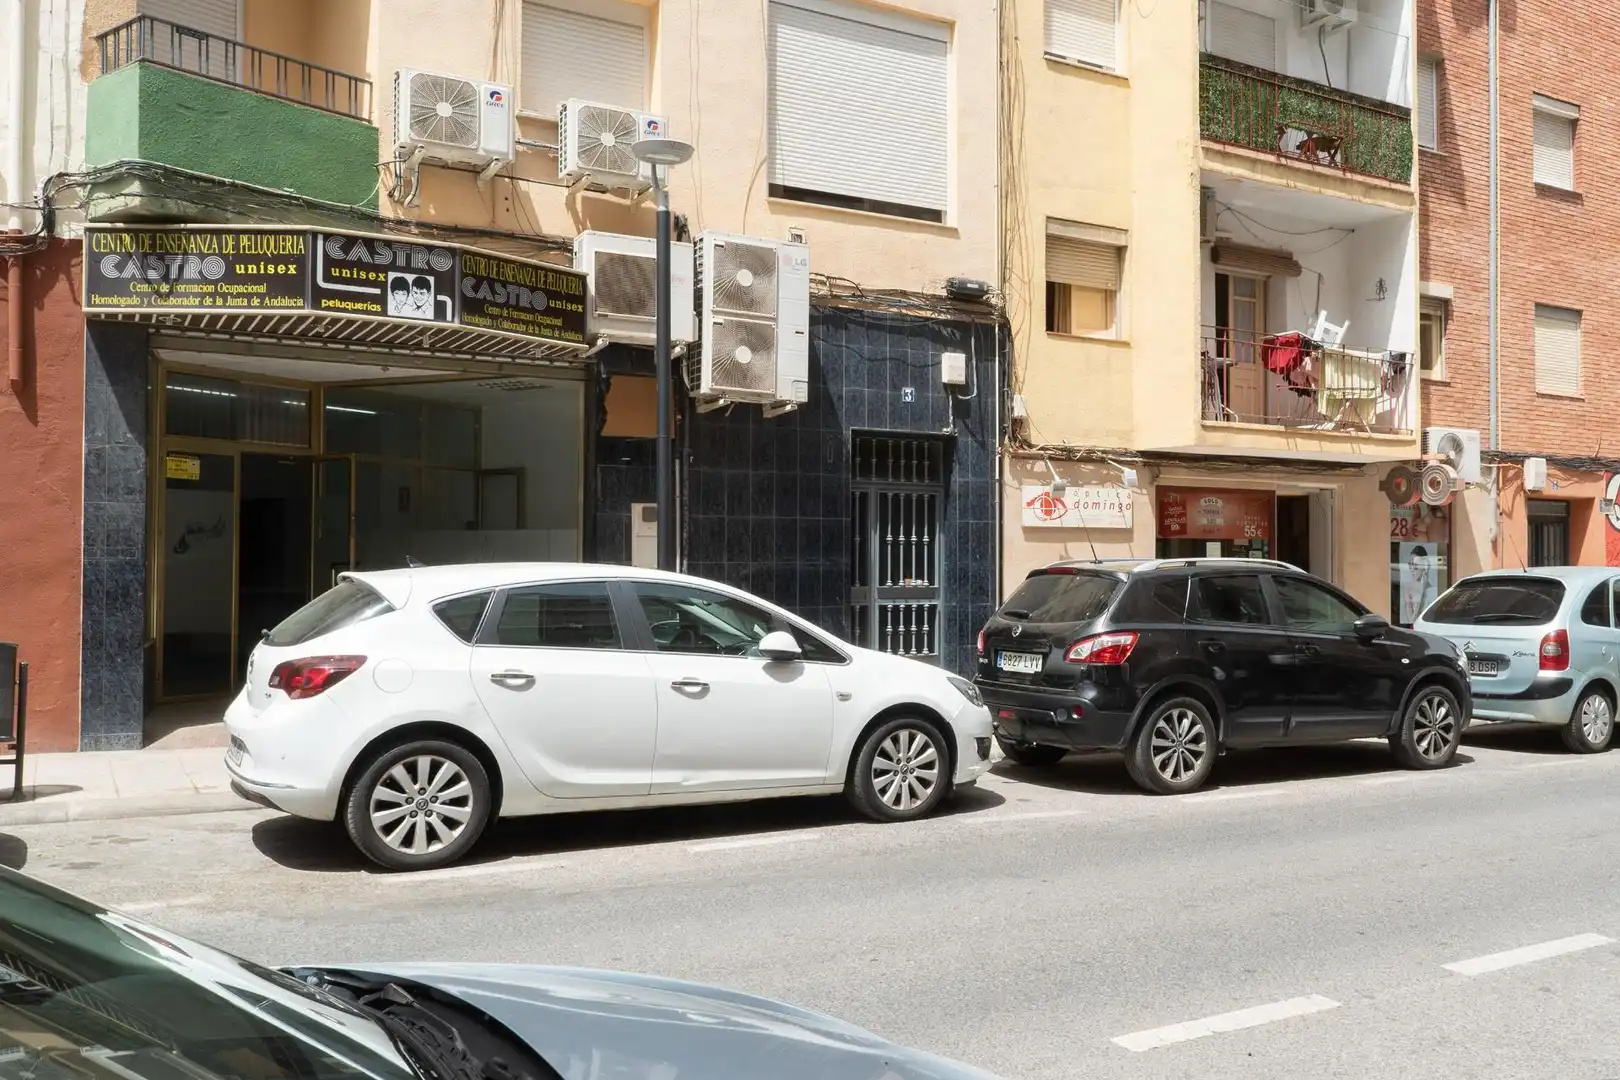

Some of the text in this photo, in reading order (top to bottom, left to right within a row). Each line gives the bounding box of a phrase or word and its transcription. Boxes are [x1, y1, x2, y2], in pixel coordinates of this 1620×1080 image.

[92, 233, 136, 252] CENTRO
[140, 233, 152, 252] DE
[156, 232, 218, 253] ENSEÑANZA
[222, 234, 236, 254] DE
[325, 236, 452, 272] CASTRO
[100, 254, 296, 280] CASTRO unisex
[795, 258, 806, 266] LG
[331, 267, 387, 282] unisex
[462, 254, 488, 276] CENTRO
[490, 260, 498, 279] DE
[538, 270, 546, 288] DE
[130, 281, 157, 292] Centro
[160, 282, 170, 292] de
[218, 282, 266, 294] Ocupacional
[462, 276, 584, 312] CASTRO unisex
[92, 294, 140, 306] Homologado
[143, 298, 149, 306] y
[152, 295, 200, 306] Colaborador
[203, 296, 212, 306] de
[216, 296, 222, 306] la
[226, 296, 248, 306] Junta
[250, 296, 260, 306] de
[904, 390, 912, 402] 3
[1074, 500, 1132, 513] domingo
[1390, 518, 1408, 536] 28
[1478, 662, 1496, 672] DSR
